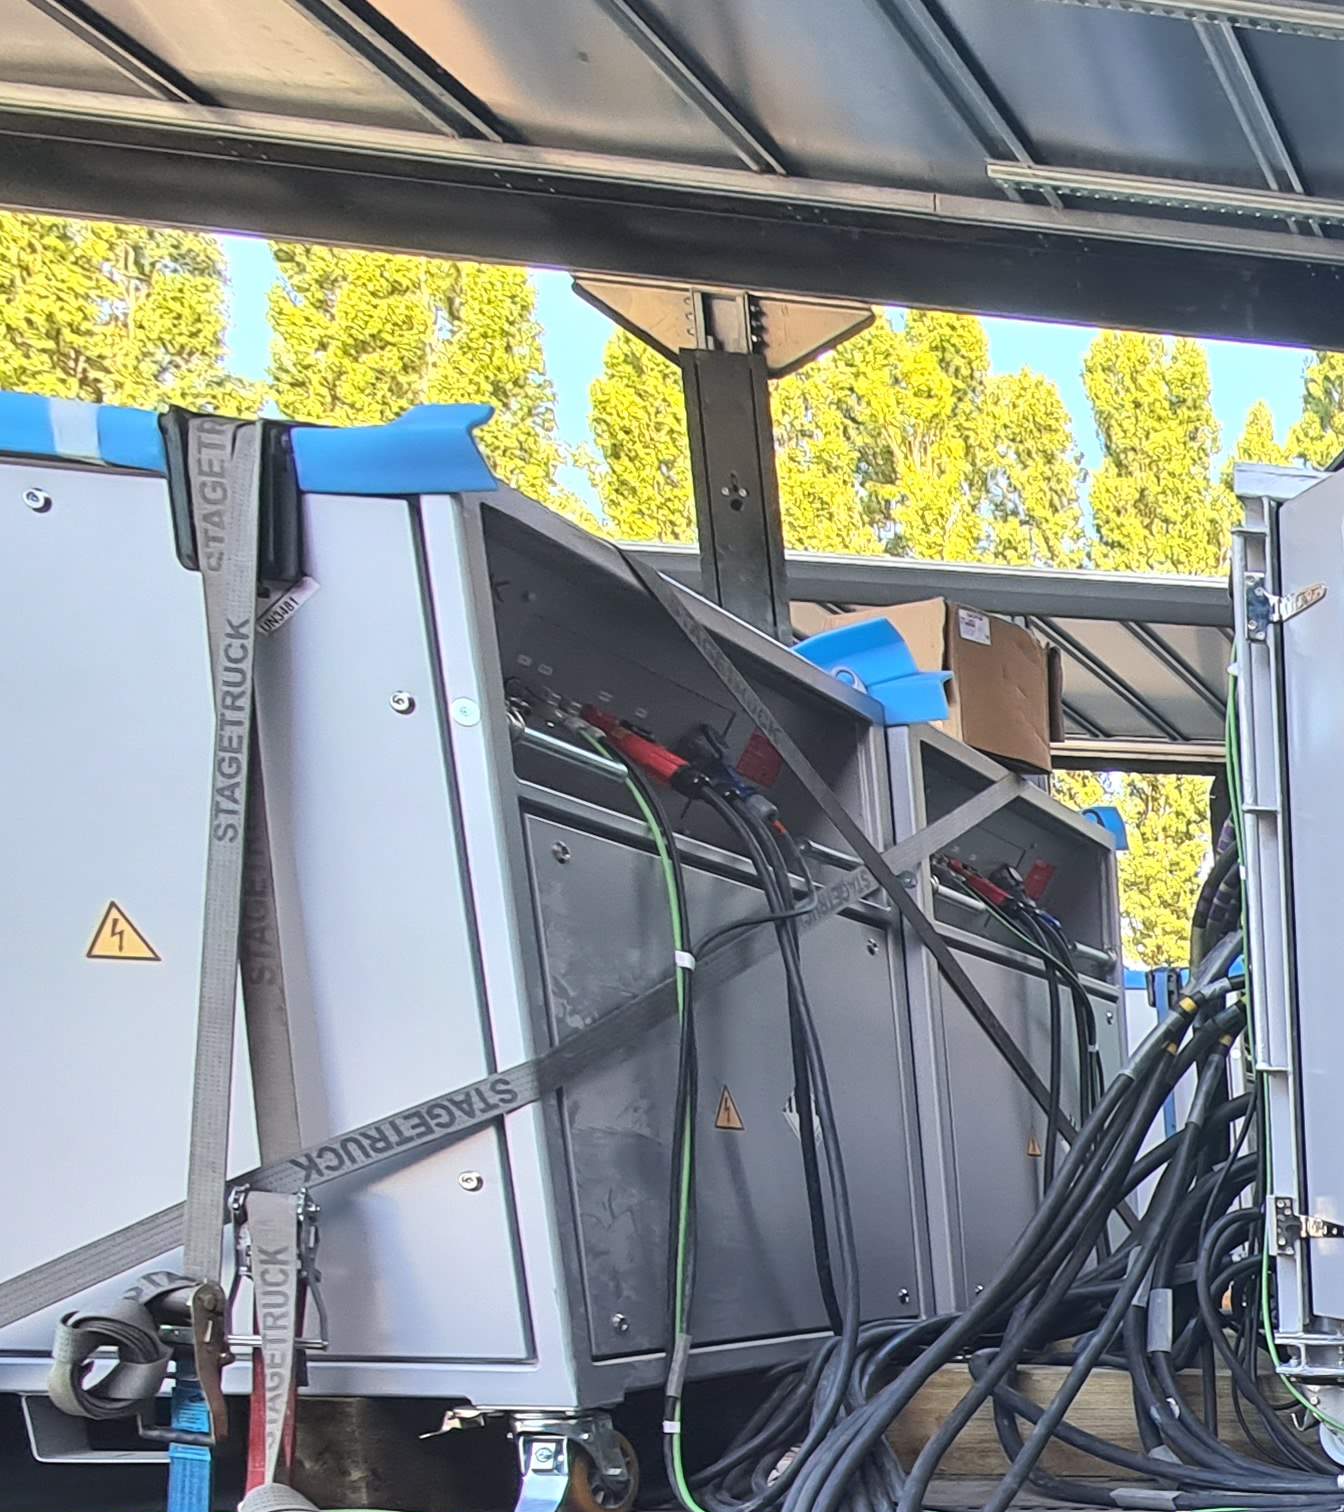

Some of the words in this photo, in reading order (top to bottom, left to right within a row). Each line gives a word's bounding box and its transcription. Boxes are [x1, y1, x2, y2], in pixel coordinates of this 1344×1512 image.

[259, 596, 299, 633] UN3481
[213, 617, 250, 843] STAGETRUCK
[288, 1077, 519, 1184] STAGETRUCK
